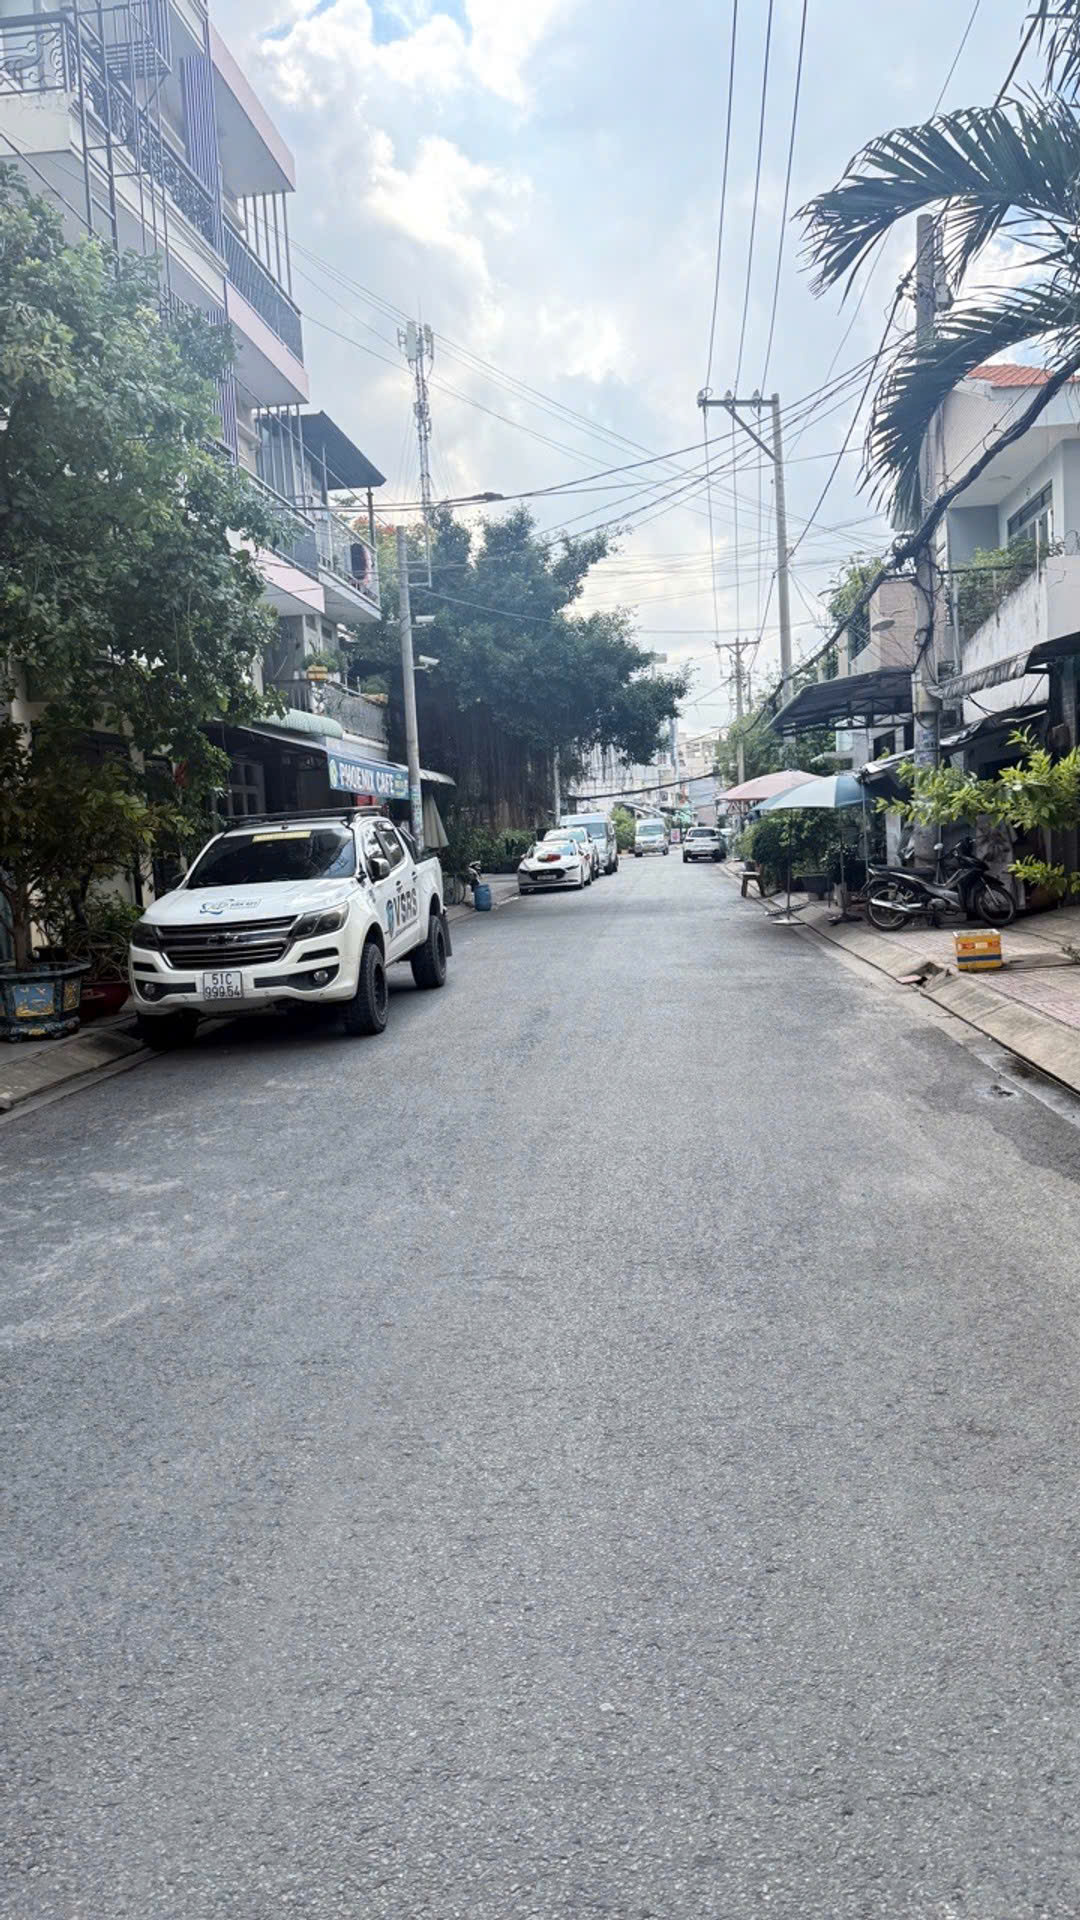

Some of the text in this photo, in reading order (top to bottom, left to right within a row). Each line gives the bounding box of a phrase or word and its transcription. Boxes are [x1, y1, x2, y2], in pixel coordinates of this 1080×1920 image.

[339, 762, 375, 793] PHOENIX
[393, 888, 417, 928] VSRS
[211, 973, 233, 985] 51C
